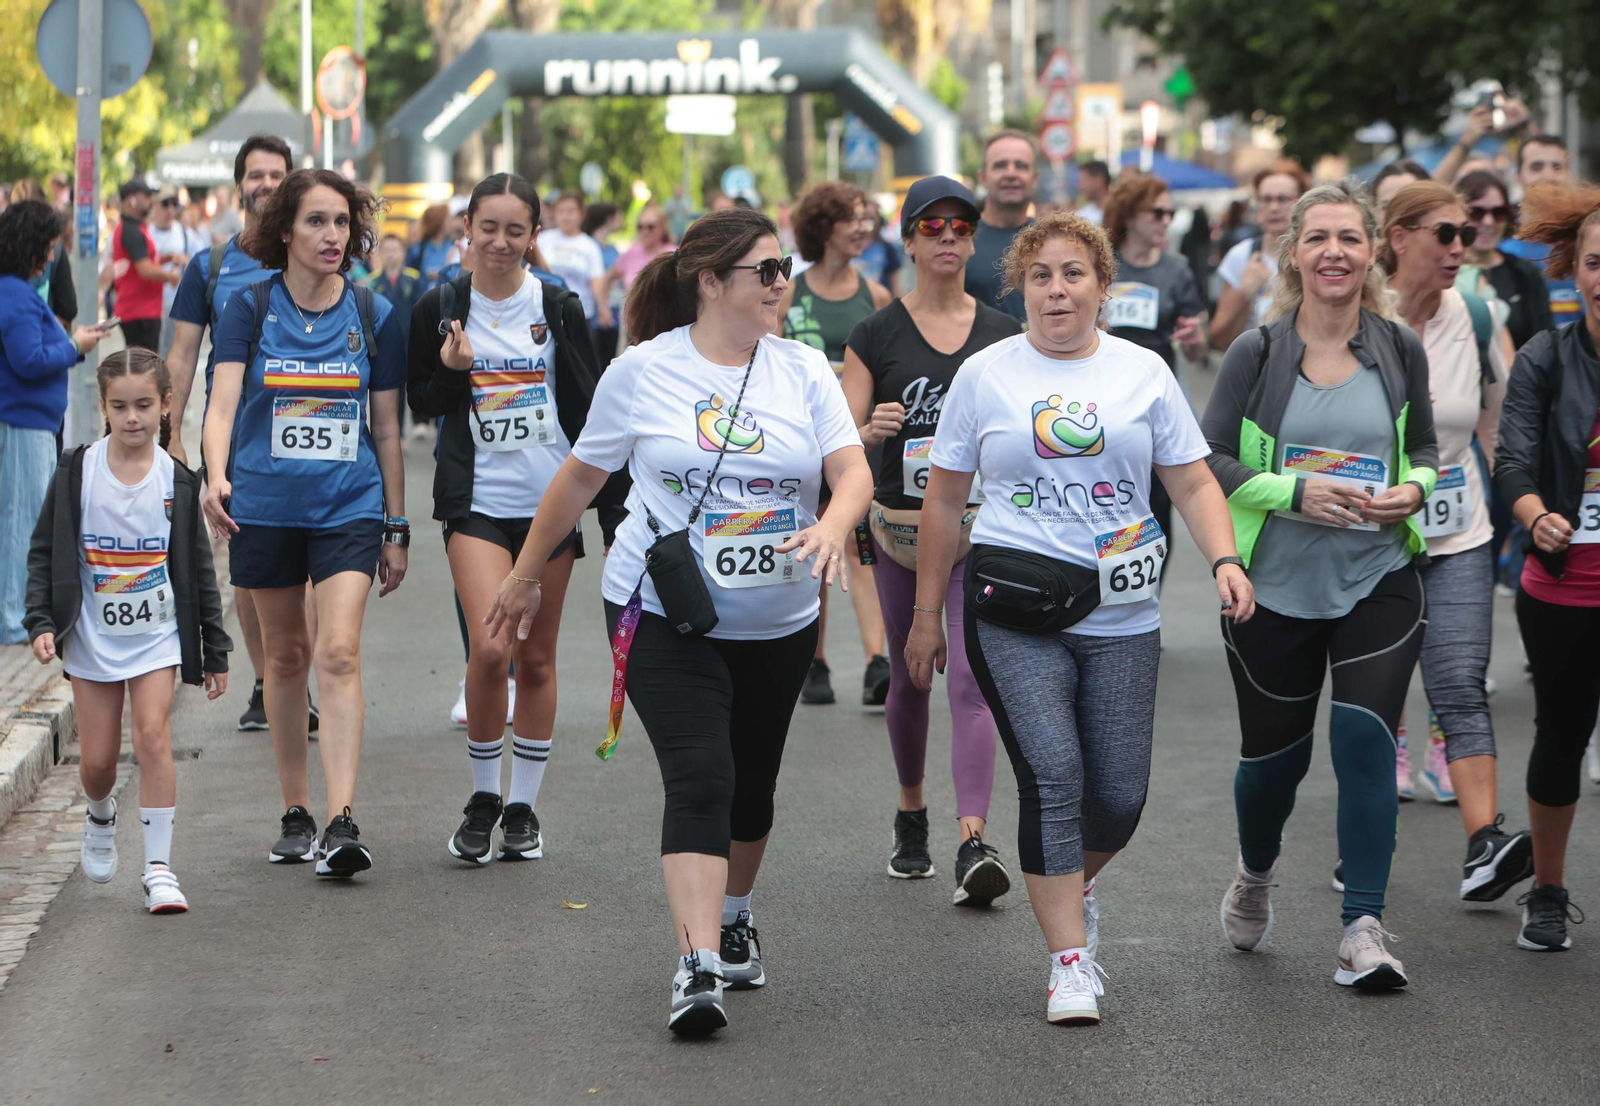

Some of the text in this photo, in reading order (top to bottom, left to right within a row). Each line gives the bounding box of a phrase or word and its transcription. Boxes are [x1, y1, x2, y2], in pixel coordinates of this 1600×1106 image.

[471, 357, 547, 371] OLICIA
[280, 402, 352, 412] CARRERA POPULAR
[509, 390, 542, 402] POPULAR
[281, 425, 332, 450] 635
[479, 416, 530, 443] 675
[1292, 451, 1380, 473] CARRERA POPULAR
[1334, 466, 1359, 477] SANTO
[1359, 471, 1383, 481] ANGEL
[659, 468, 802, 498] afines
[1010, 477, 1136, 509] afines
[711, 513, 791, 526] CARRERA POPULAR
[756, 524, 777, 533] SANTO
[82, 533, 166, 551] POLICI
[716, 544, 776, 577] 628
[1110, 555, 1157, 593] 632
[103, 599, 152, 626] 684
[614, 669, 624, 703] afines
